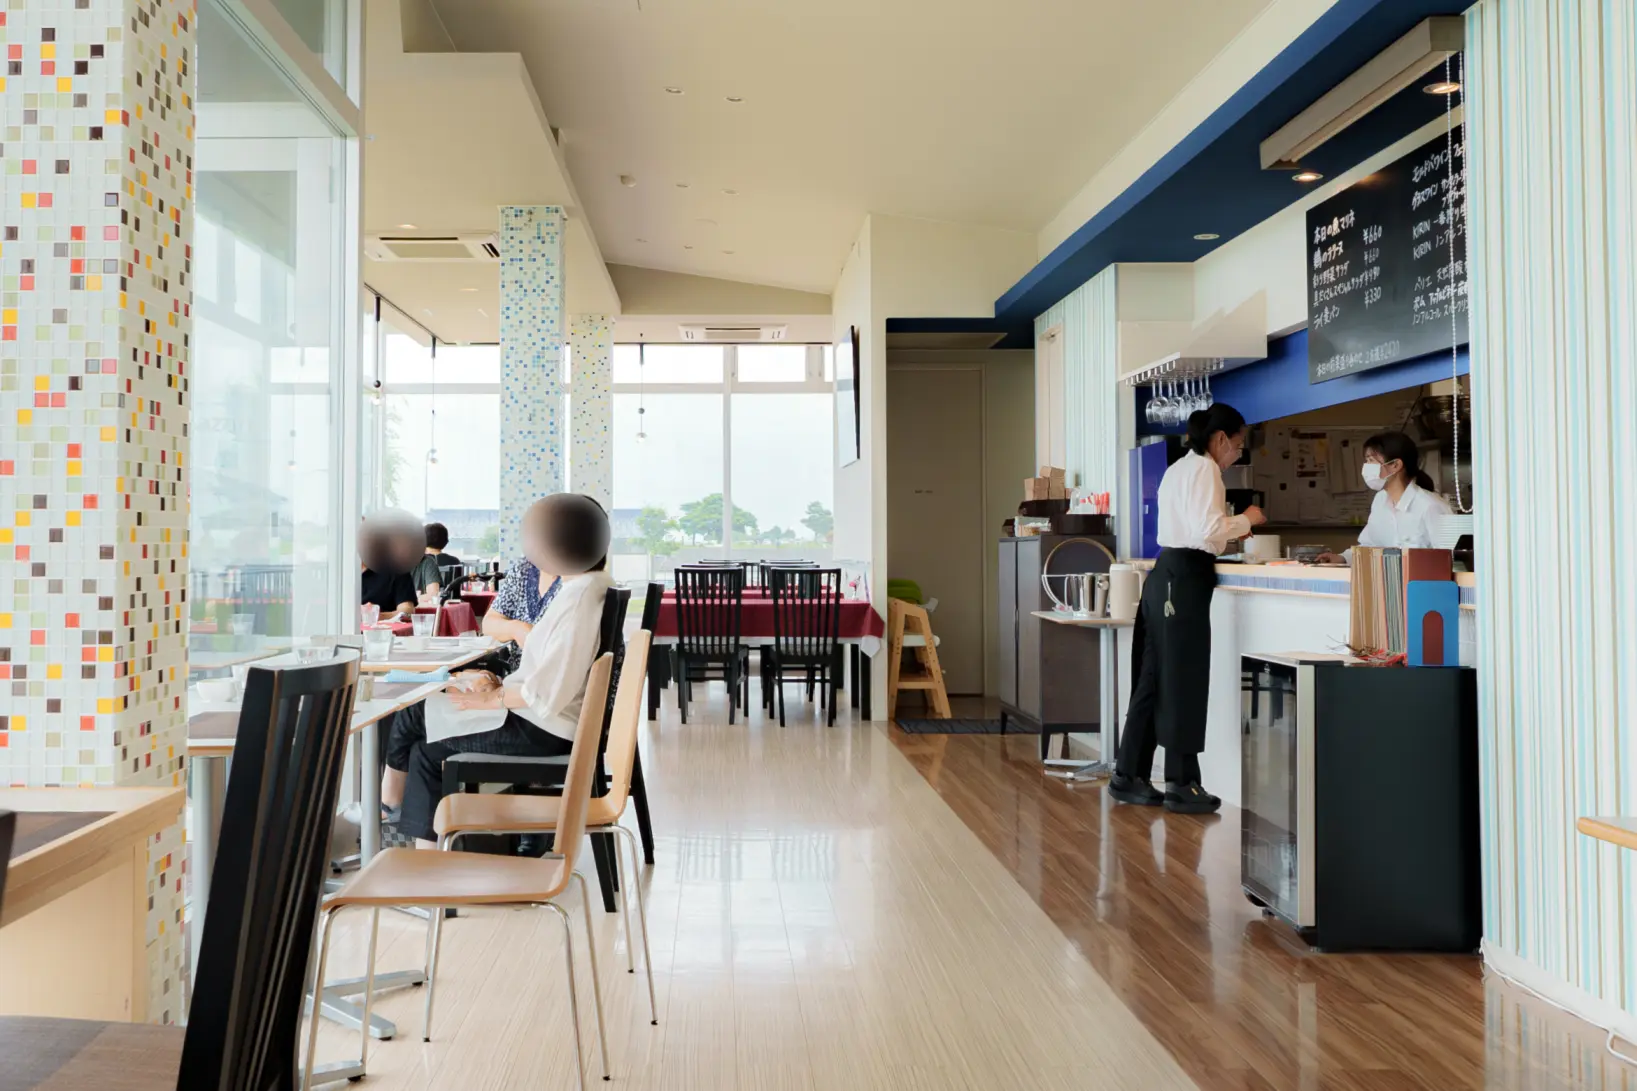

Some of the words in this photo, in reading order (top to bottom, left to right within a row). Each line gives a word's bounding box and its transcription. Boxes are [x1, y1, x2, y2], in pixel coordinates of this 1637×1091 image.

[1412, 219, 1431, 240] KIRIN
[1413, 241, 1432, 260] KIRIN
[1364, 286, 1382, 310] ¥330
